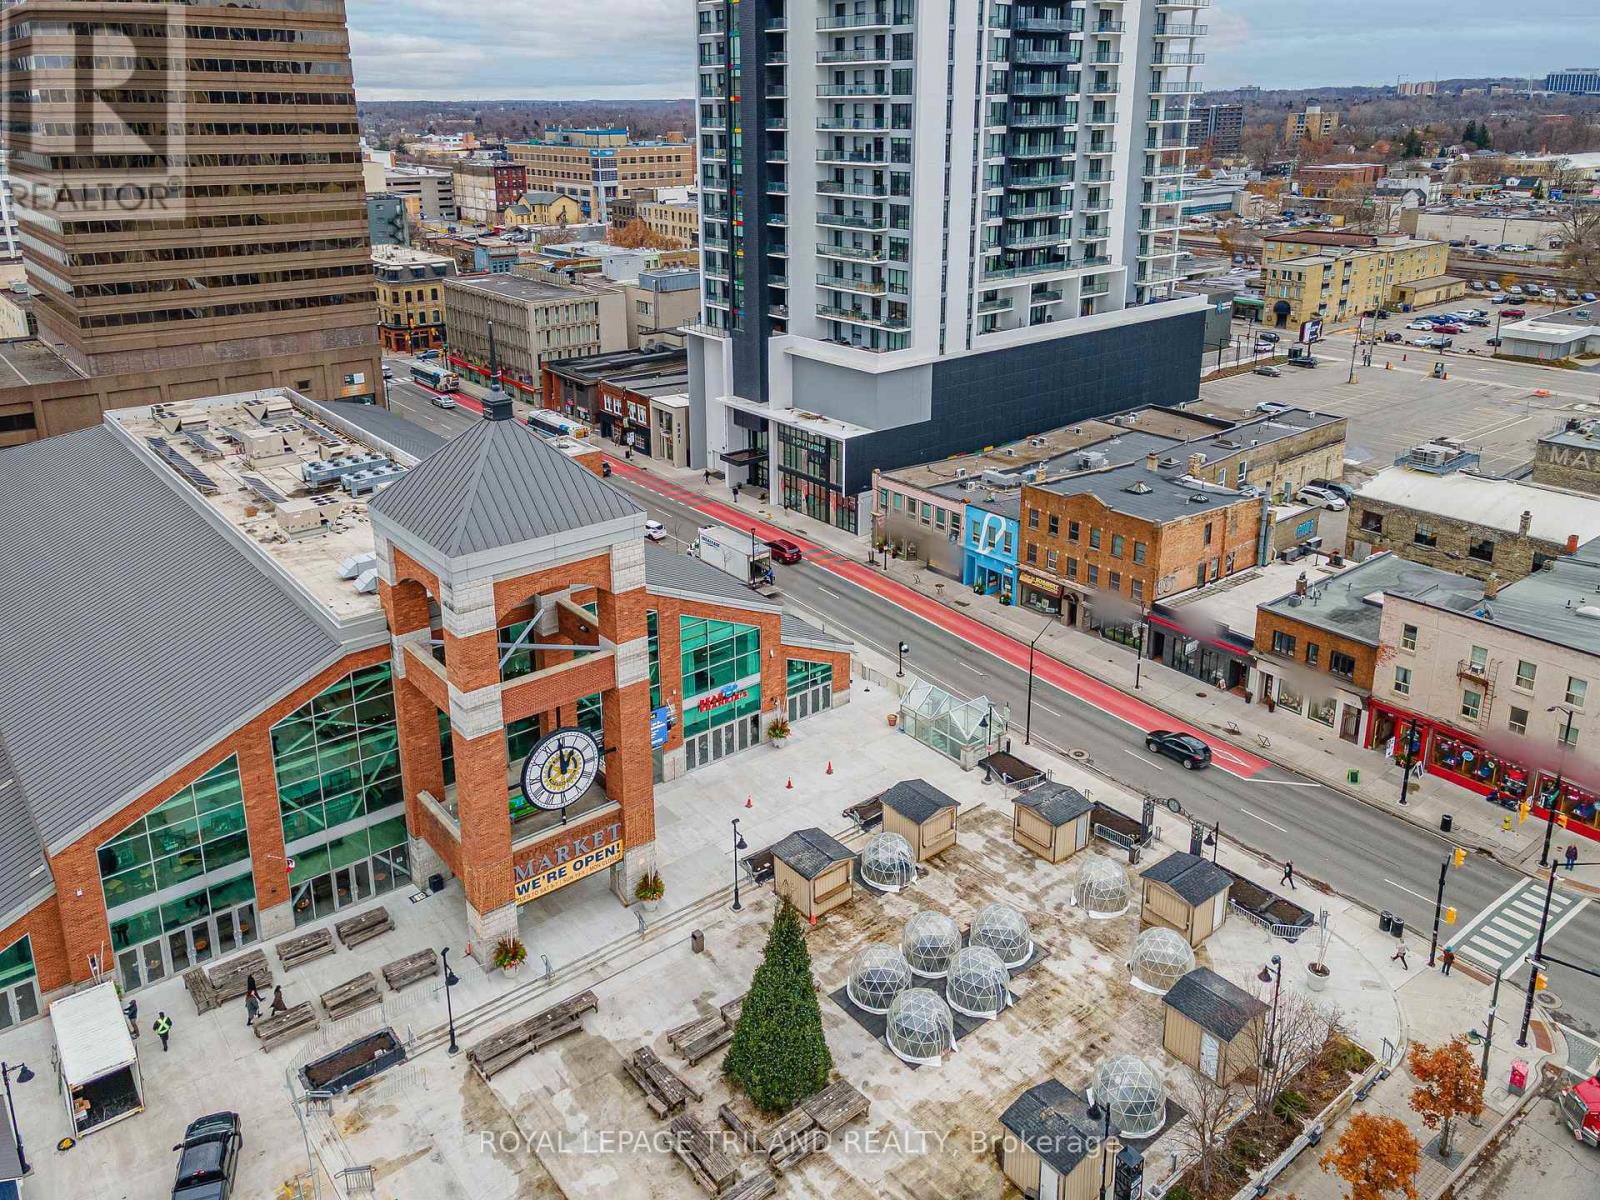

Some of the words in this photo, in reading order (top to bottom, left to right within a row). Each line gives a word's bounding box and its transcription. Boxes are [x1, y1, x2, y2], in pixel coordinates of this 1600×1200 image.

[1549, 446, 1600, 471] MA
[513, 823, 621, 882] MARKET
[516, 866, 567, 896] WE'RE
[573, 843, 620, 871] OPEN!
